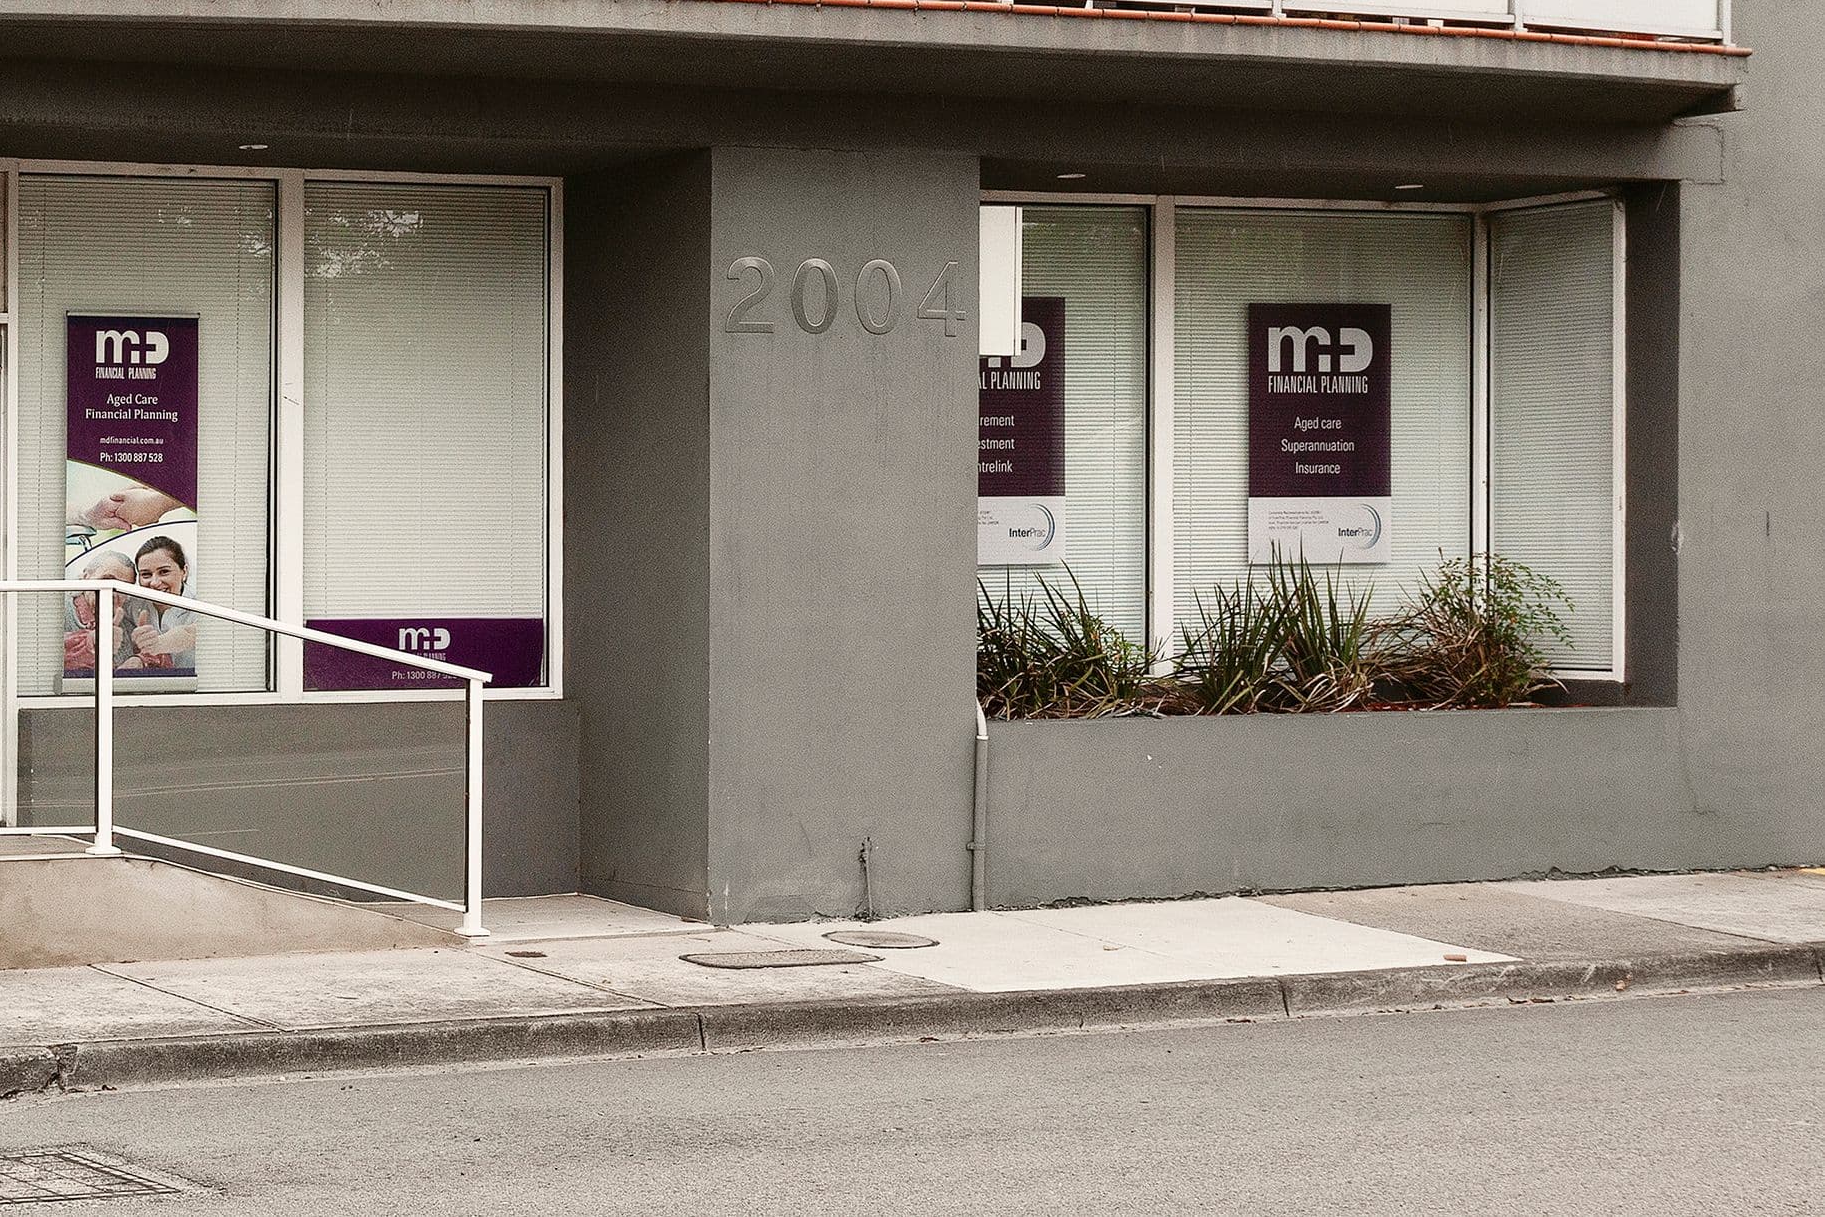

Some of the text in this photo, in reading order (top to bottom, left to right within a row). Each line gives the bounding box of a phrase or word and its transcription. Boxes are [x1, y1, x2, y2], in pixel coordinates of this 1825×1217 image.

[725, 256, 966, 337] 2004
[95, 367, 157, 380] FINANCIAL PLANNING
[990, 371, 1041, 390] PLANNING
[1268, 375, 1368, 394] FINANCIAL PLANNING
[106, 393, 159, 407] Aged Care
[85, 408, 179, 422] Financial Planning
[979, 414, 1015, 427] rement
[1294, 416, 1342, 432] Aged care
[99, 435, 164, 445] mdfinancial.com.au
[977, 438, 1015, 450] estment
[1281, 438, 1355, 454] Superannuation
[100, 452, 163, 462] Ph: 1300 887 528
[977, 459, 1013, 473] ntrelink
[1295, 461, 1341, 475] Insurance
[407, 671, 426, 680] 1300
